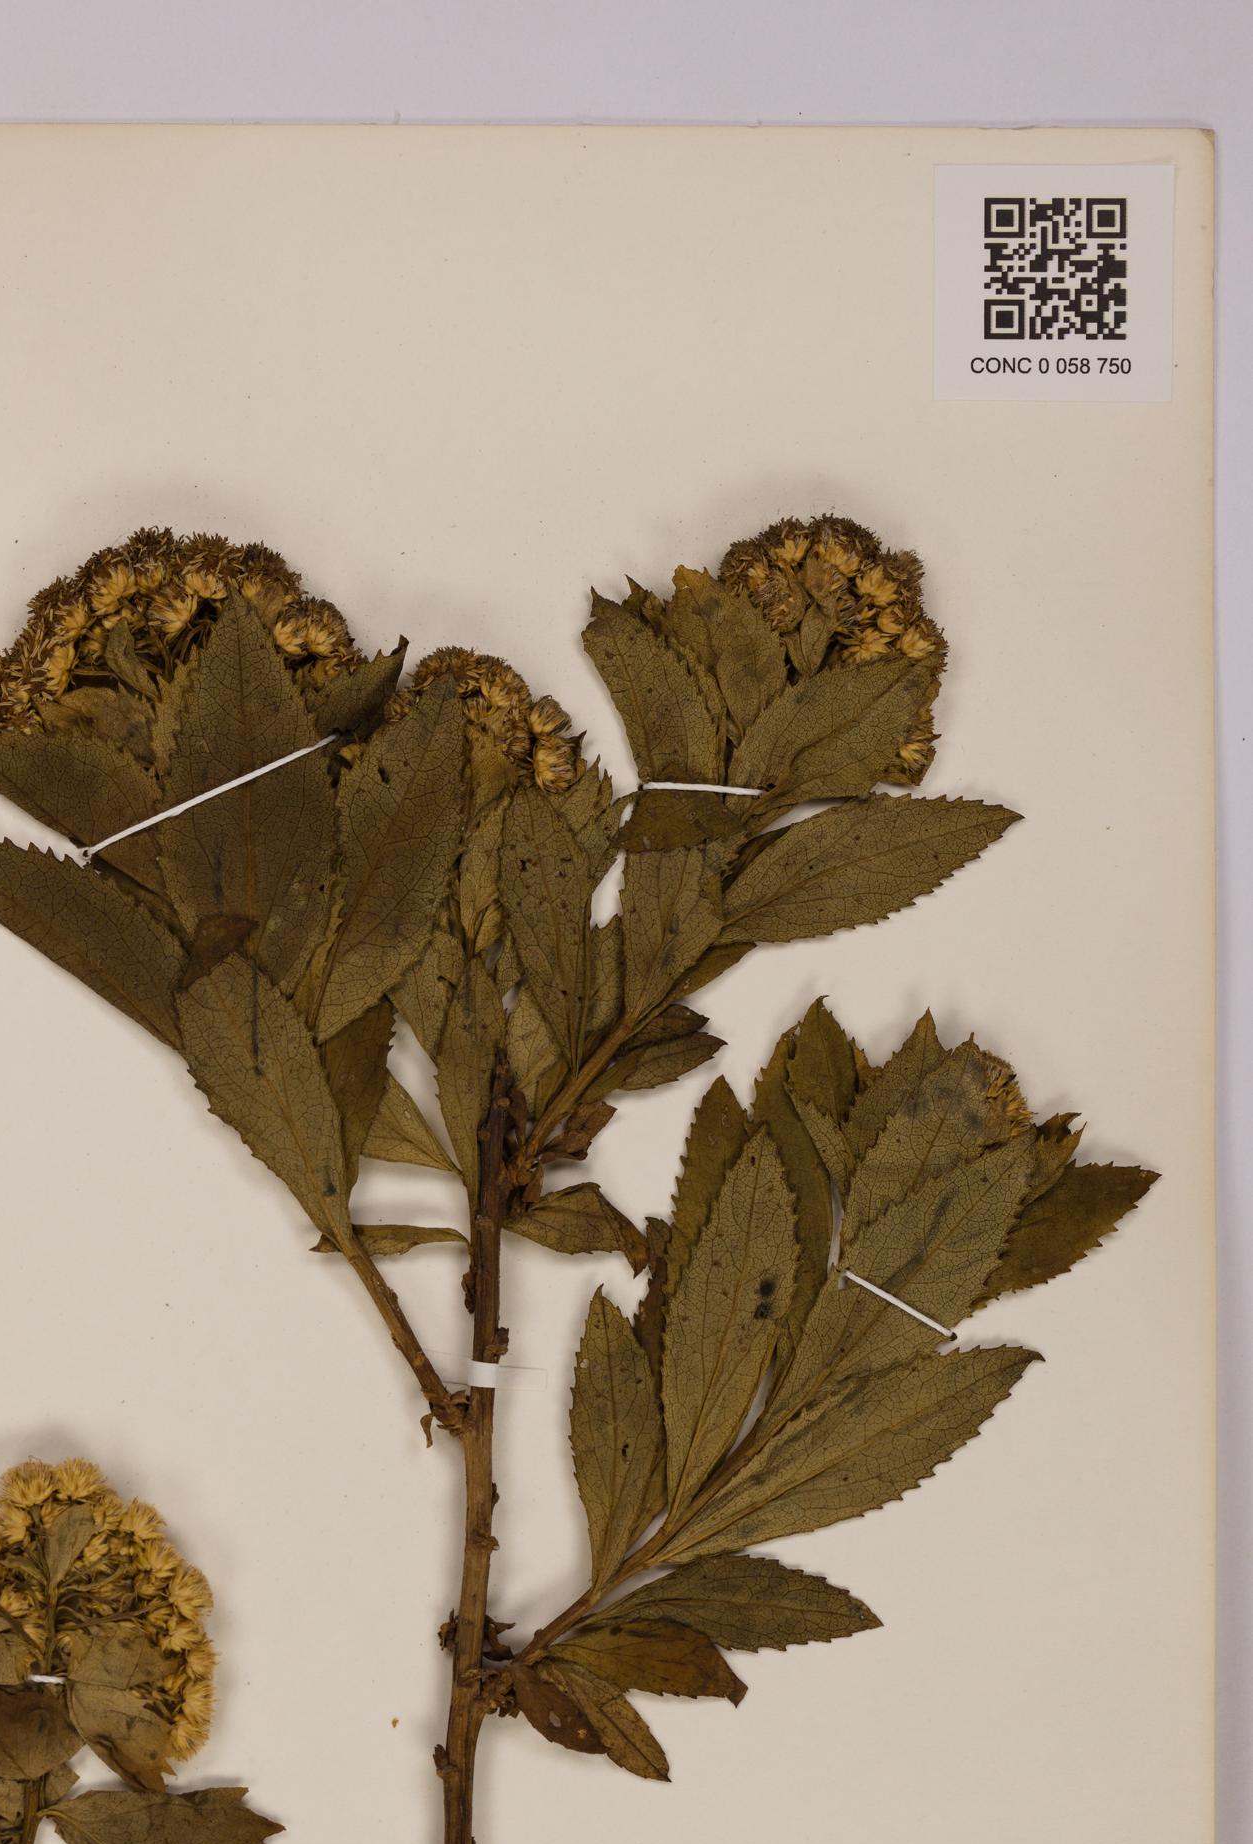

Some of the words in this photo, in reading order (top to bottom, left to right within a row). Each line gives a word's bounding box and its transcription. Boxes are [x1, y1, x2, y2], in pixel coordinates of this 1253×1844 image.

[970, 356, 1032, 375] CONC
[1038, 357, 1050, 375] 0
[1056, 357, 1091, 375] 058
[1096, 357, 1132, 375] 750
